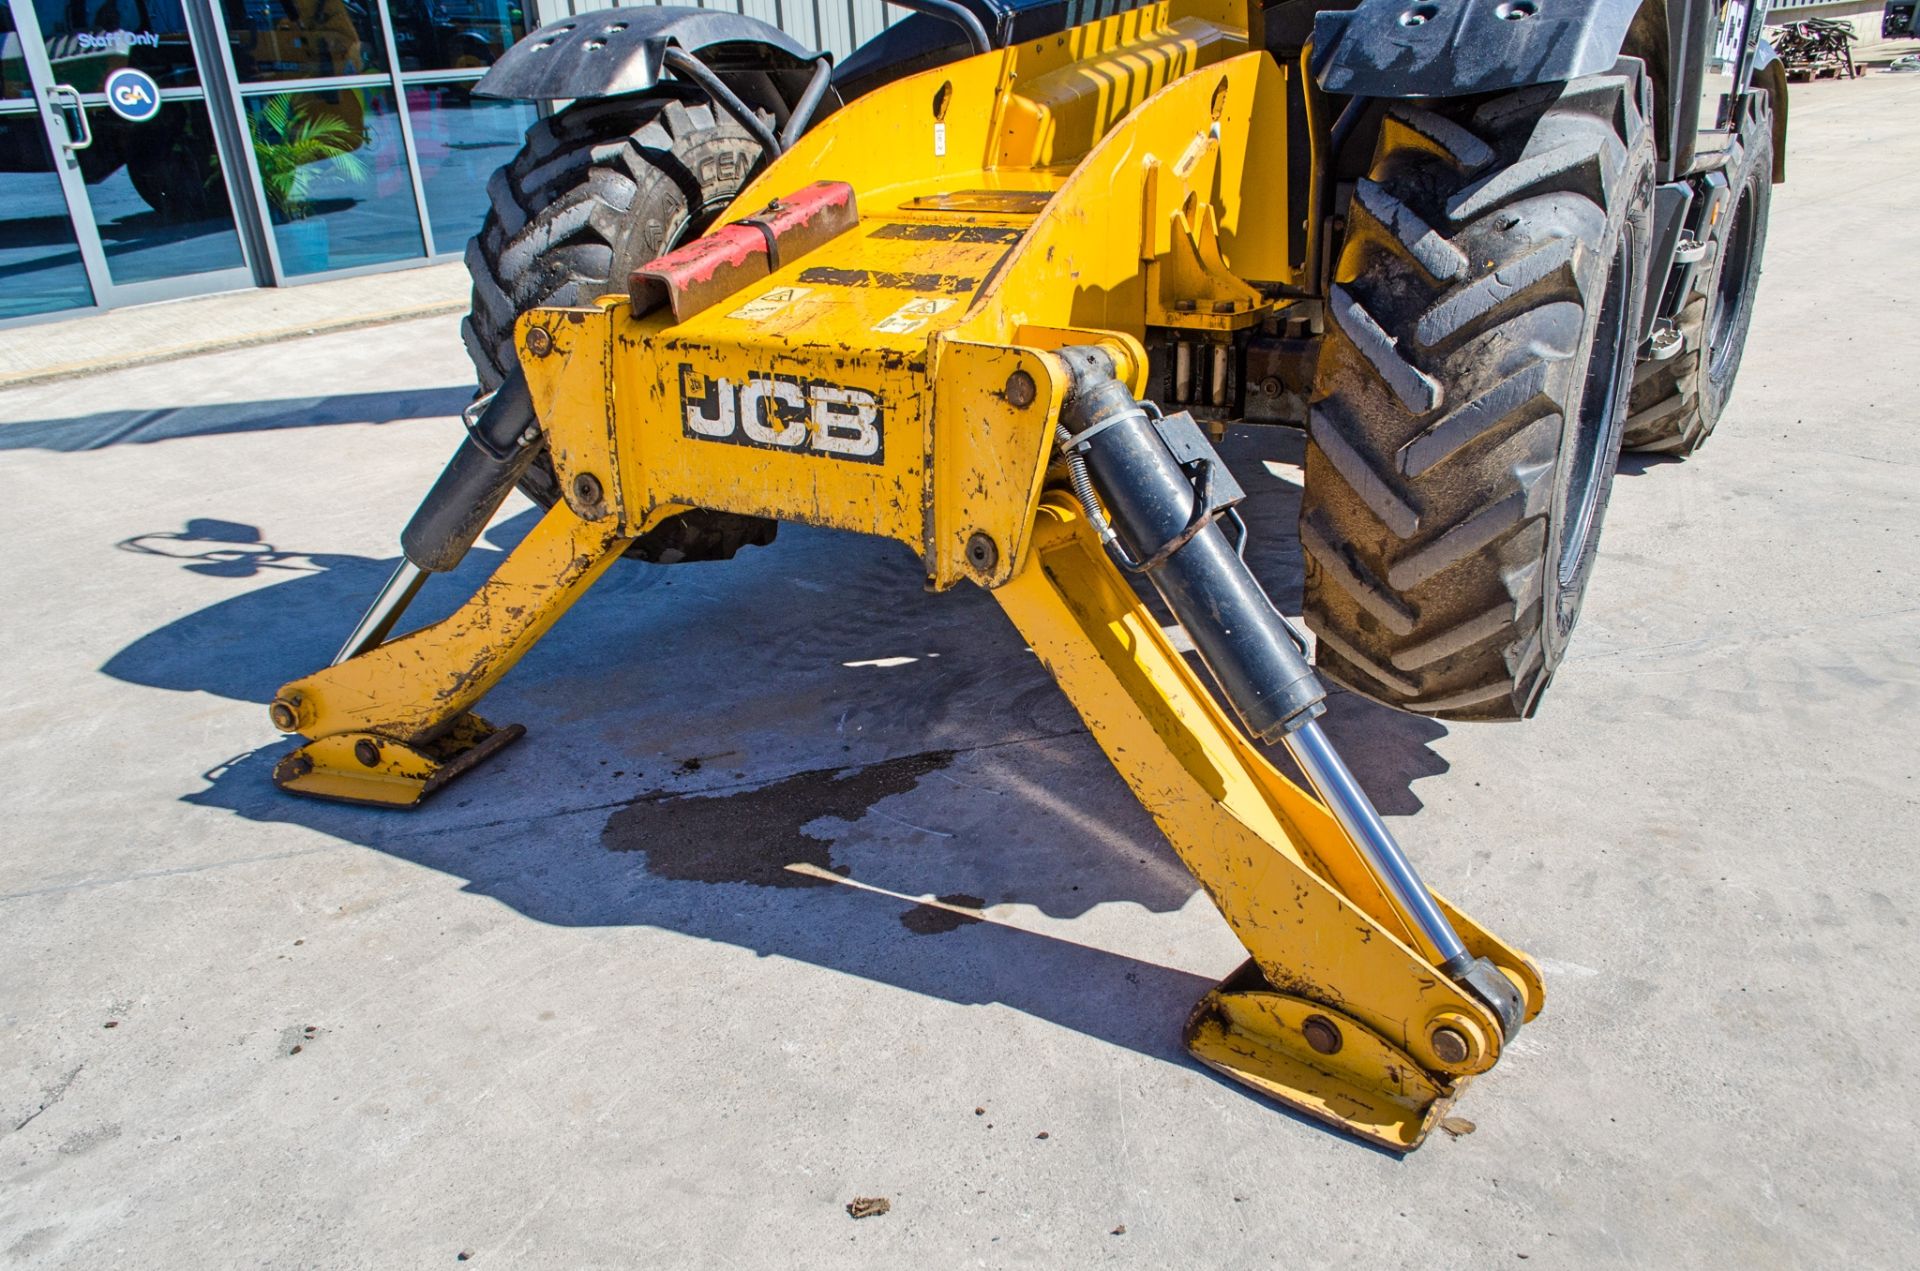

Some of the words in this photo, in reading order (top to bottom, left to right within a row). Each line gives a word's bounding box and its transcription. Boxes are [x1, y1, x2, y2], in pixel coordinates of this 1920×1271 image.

[78, 31, 121, 49] Staff
[124, 30, 159, 48] Only
[115, 85, 152, 105] GA
[686, 376, 880, 457] JCB
